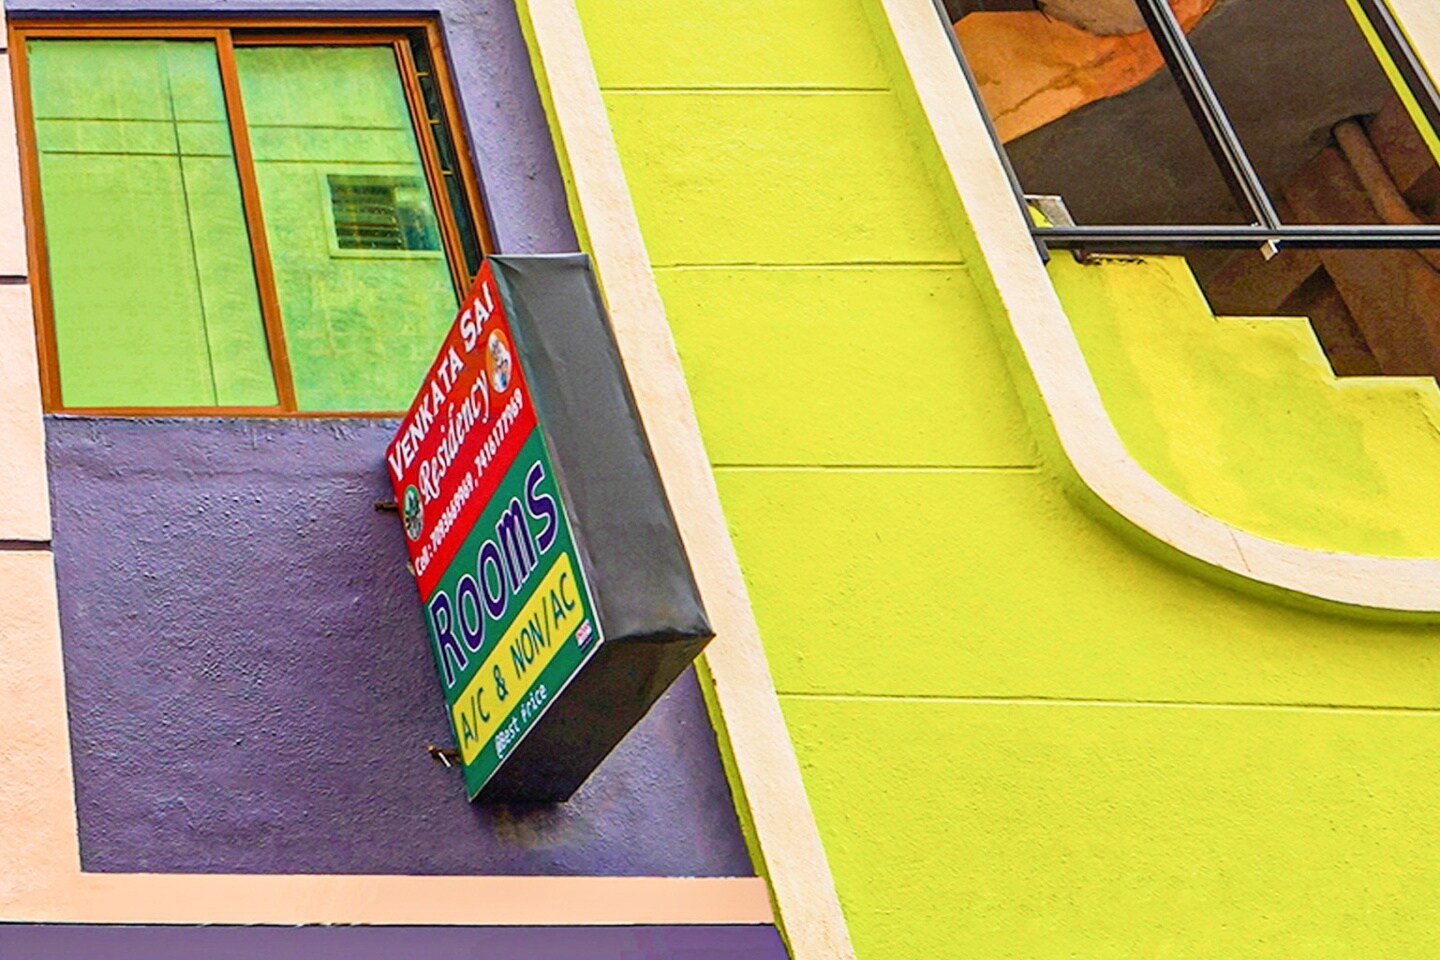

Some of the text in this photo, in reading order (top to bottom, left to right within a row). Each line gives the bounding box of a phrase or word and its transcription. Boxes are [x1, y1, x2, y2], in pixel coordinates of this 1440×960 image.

[388, 281, 495, 482] VENKATA SAI
[418, 370, 490, 505] Residency
[461, 571, 575, 749] A/C & NON/AC
